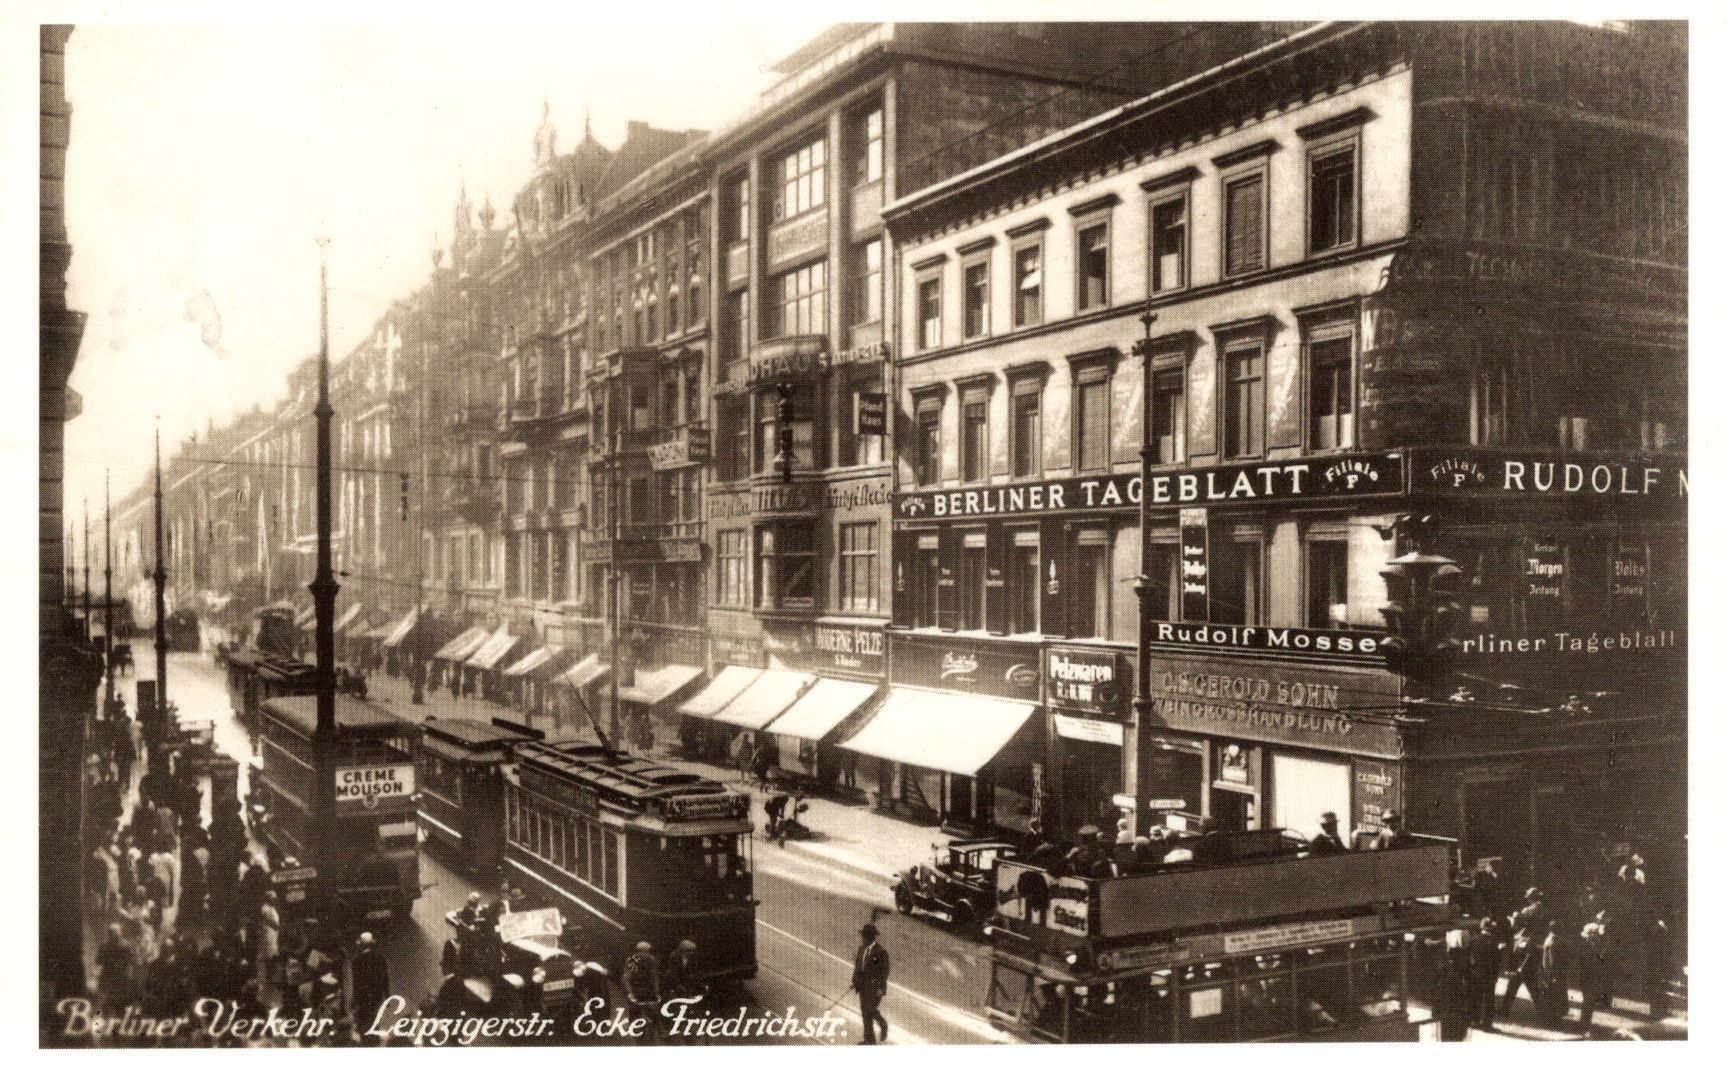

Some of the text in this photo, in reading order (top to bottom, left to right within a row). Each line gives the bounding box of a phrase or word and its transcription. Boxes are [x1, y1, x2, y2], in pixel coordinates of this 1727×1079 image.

[1325, 460, 1379, 482] Filiale
[1431, 458, 1485, 482] Filiale
[1454, 474, 1466, 487] F
[1503, 461, 1661, 495] RUDOLF
[934, 484, 1066, 516] BERLINER
[1081, 464, 1310, 506] TAGEBLATT
[1347, 475, 1359, 488] F
[1158, 623, 1378, 652] Rudolf Mosse
[1462, 633, 1547, 654] rliner
[1277, 681, 1340, 709] SOHN
[343, 769, 396, 783] CREME
[336, 782, 403, 797] MOUSON
